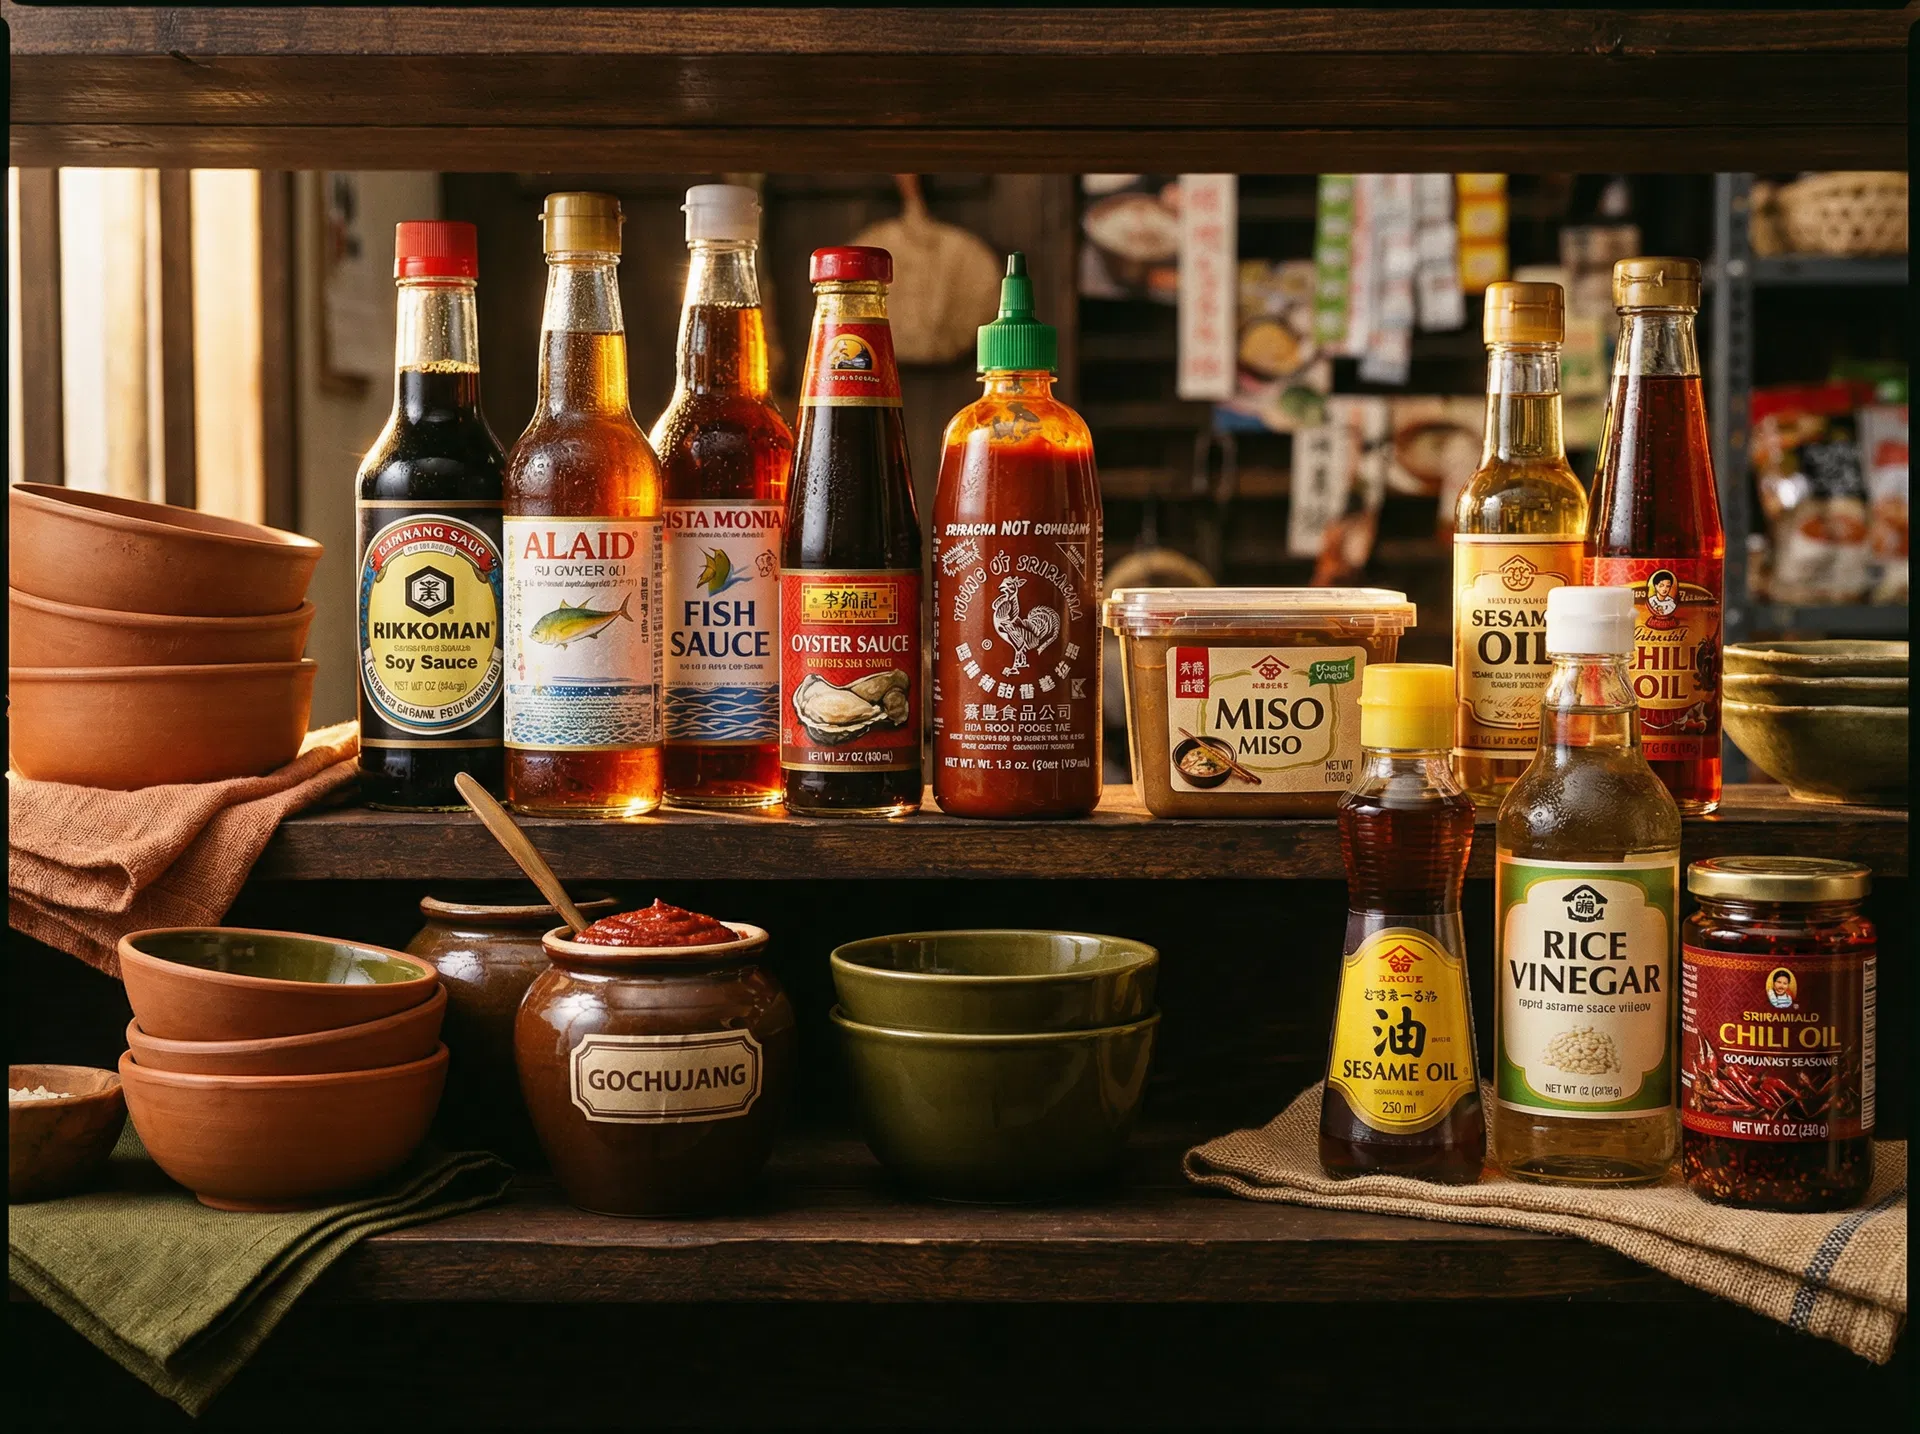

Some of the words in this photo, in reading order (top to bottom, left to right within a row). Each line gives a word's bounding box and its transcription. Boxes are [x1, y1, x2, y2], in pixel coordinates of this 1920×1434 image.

[662, 511, 709, 529] ISTA
[1001, 520, 1031, 537] NOT
[523, 531, 635, 560] ALAID
[684, 599, 755, 627] FISH
[1472, 609, 1547, 628] SESAM
[374, 621, 491, 640] RIKKOMAN
[670, 631, 771, 658] SAUCE
[791, 634, 853, 654] OYSTER
[857, 634, 909, 653] SAUCE
[1477, 629, 1553, 666] OIL
[385, 653, 415, 673] Soy
[421, 654, 478, 670] Sauce
[1629, 645, 1697, 671] HILI
[1633, 674, 1689, 700] OIL
[1214, 697, 1325, 731] MISO
[1238, 735, 1303, 756] MISO
[1325, 760, 1339, 771] NET
[1341, 759, 1354, 770] WT
[1543, 930, 1628, 962] RICE
[1509, 960, 1662, 998] VINEGAR
[1373, 1005, 1427, 1059] 油
[1719, 1022, 1789, 1048] CHILI
[1798, 1026, 1842, 1049] OIL
[588, 1063, 747, 1092] GOCHUJANG
[1343, 1059, 1419, 1082] SESAME
[1426, 1062, 1458, 1081] OIL
[1545, 1083, 1561, 1094] NET
[1564, 1084, 1578, 1095] WT
[1382, 1101, 1402, 1114] 250
[1404, 1102, 1416, 1114] ml
[1732, 1120, 1753, 1135] NET
[1753, 1123, 1772, 1137] WT.
[1773, 1124, 1780, 1136] 6
[1781, 1124, 1797, 1137] OZ
